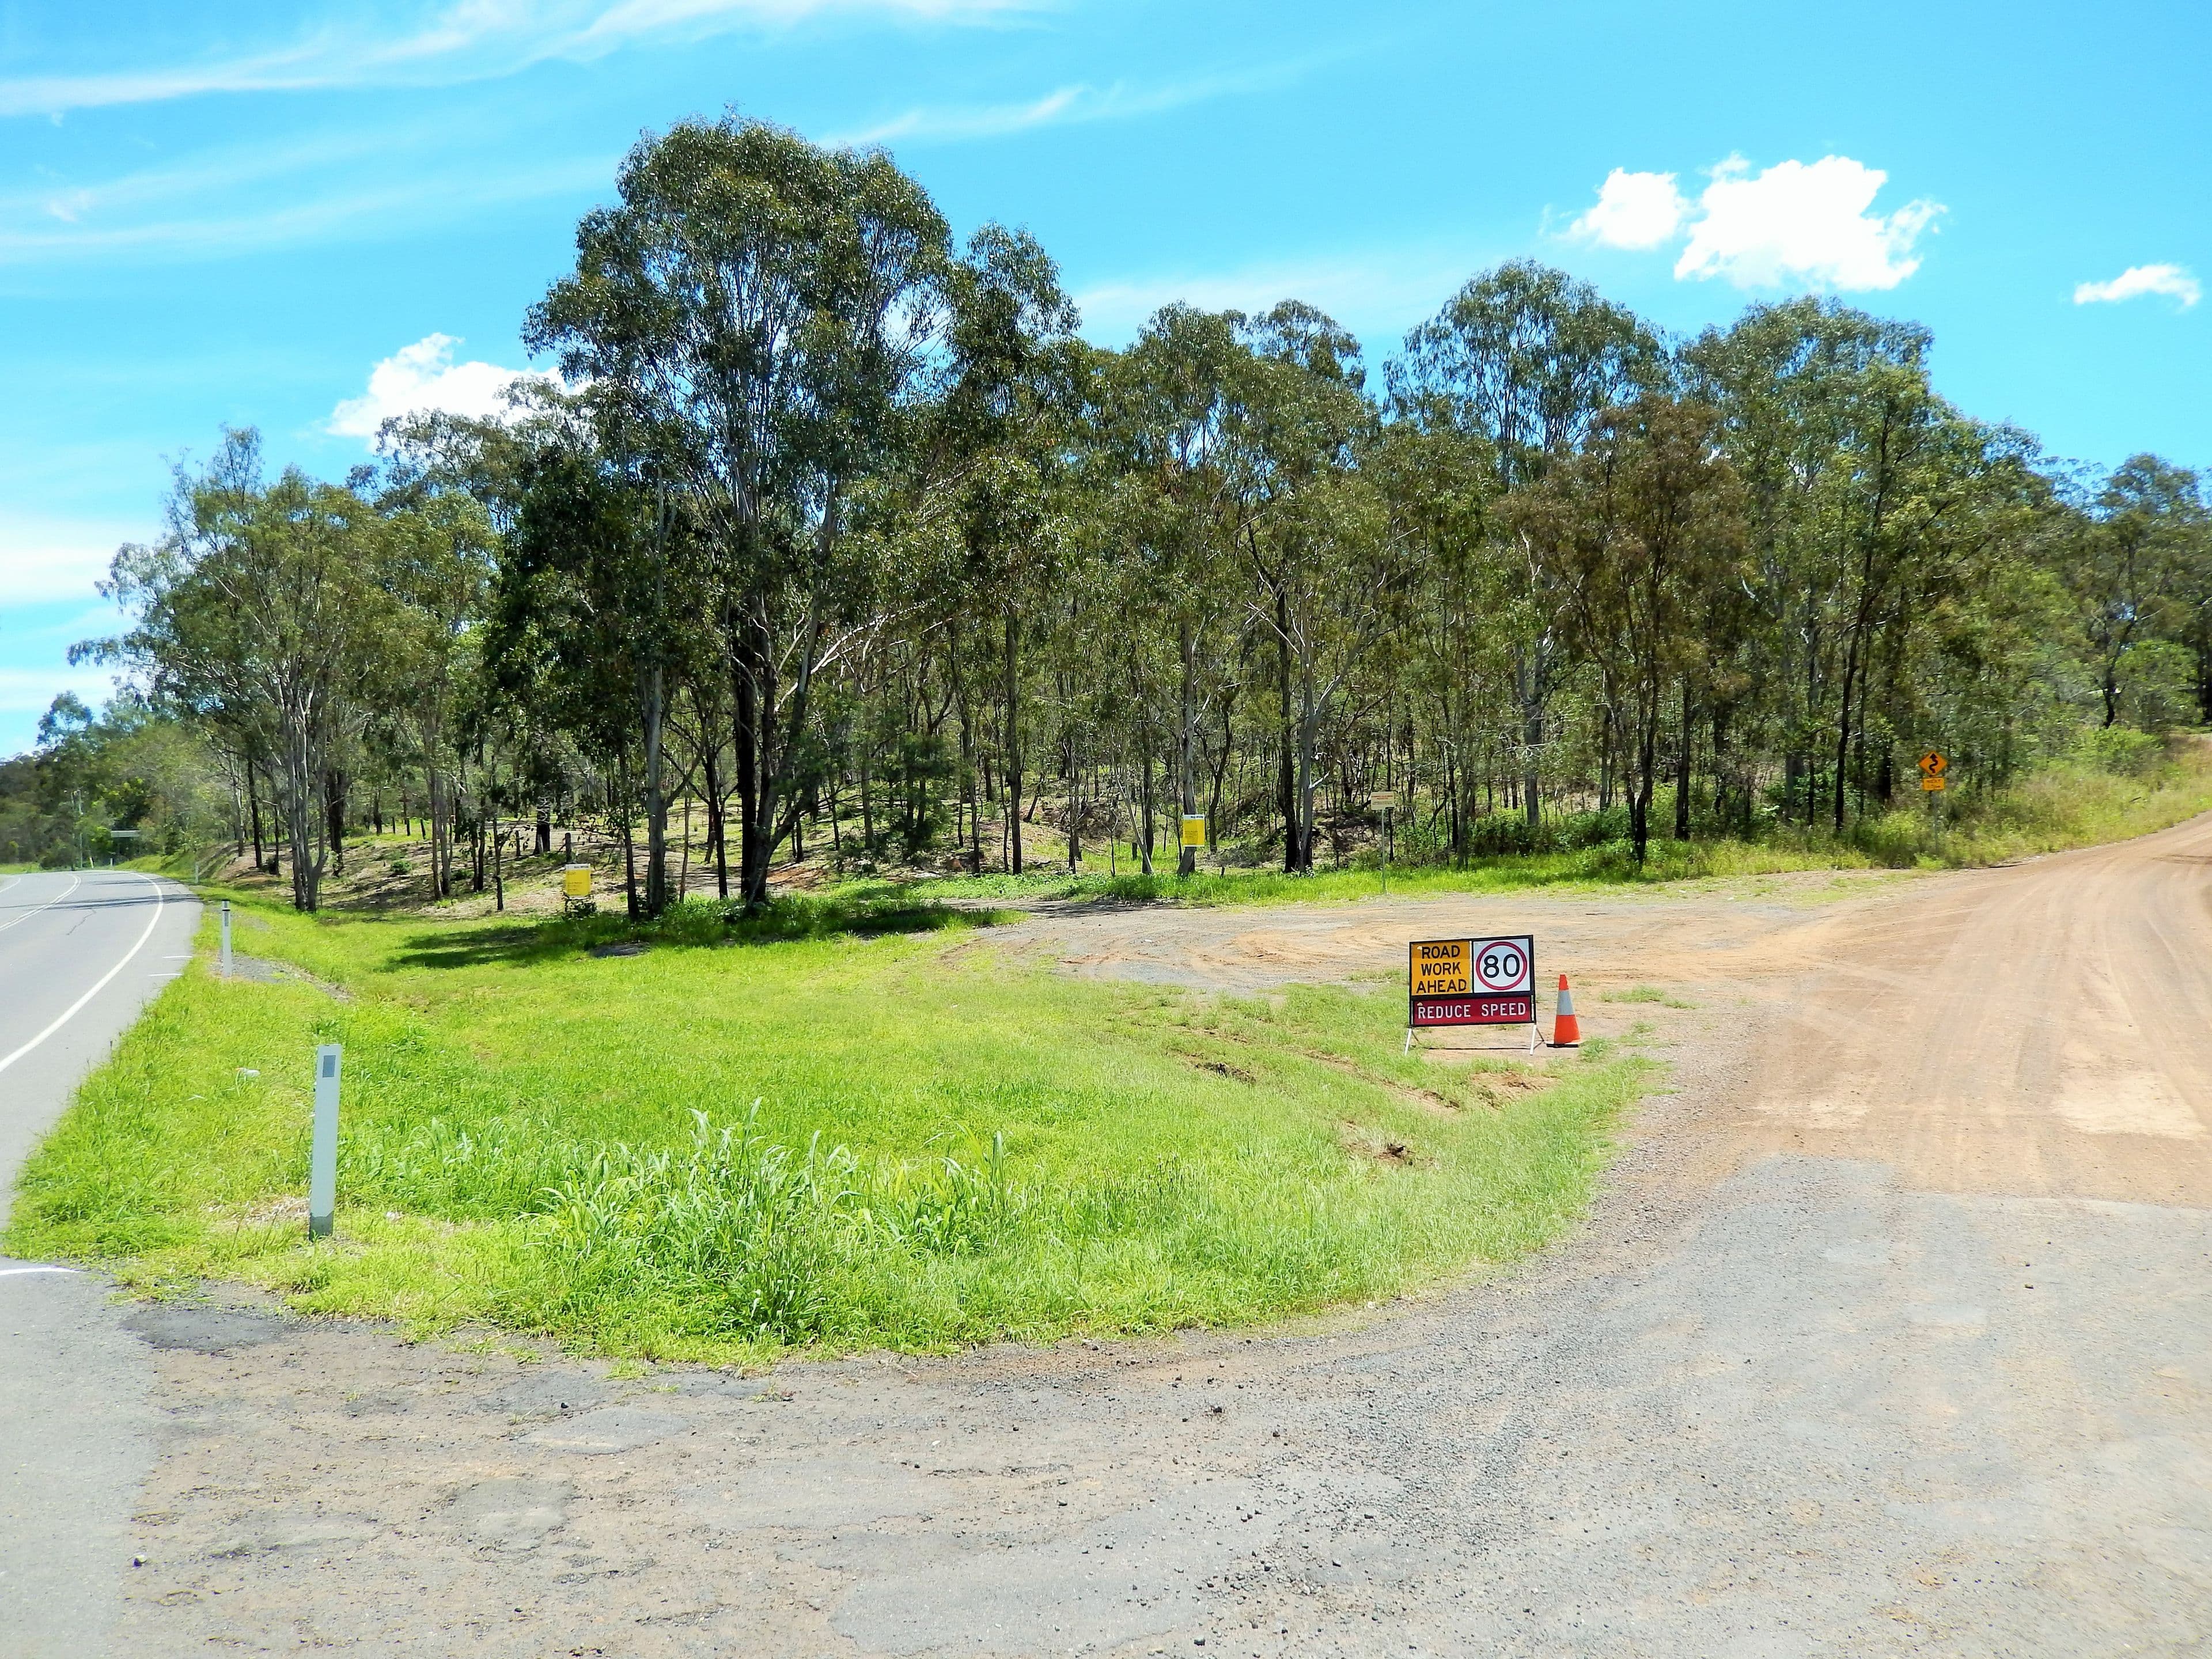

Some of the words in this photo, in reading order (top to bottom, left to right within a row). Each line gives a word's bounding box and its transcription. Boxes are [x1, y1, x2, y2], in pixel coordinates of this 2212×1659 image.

[1422, 945, 1460, 959] ROAD
[1421, 962, 1461, 976] WORK
[1483, 954, 1520, 978] 80
[1416, 979, 1467, 993] AHEAD
[1418, 1005, 1471, 1018] REDUCE
[1481, 1002, 1526, 1016] SPEED
